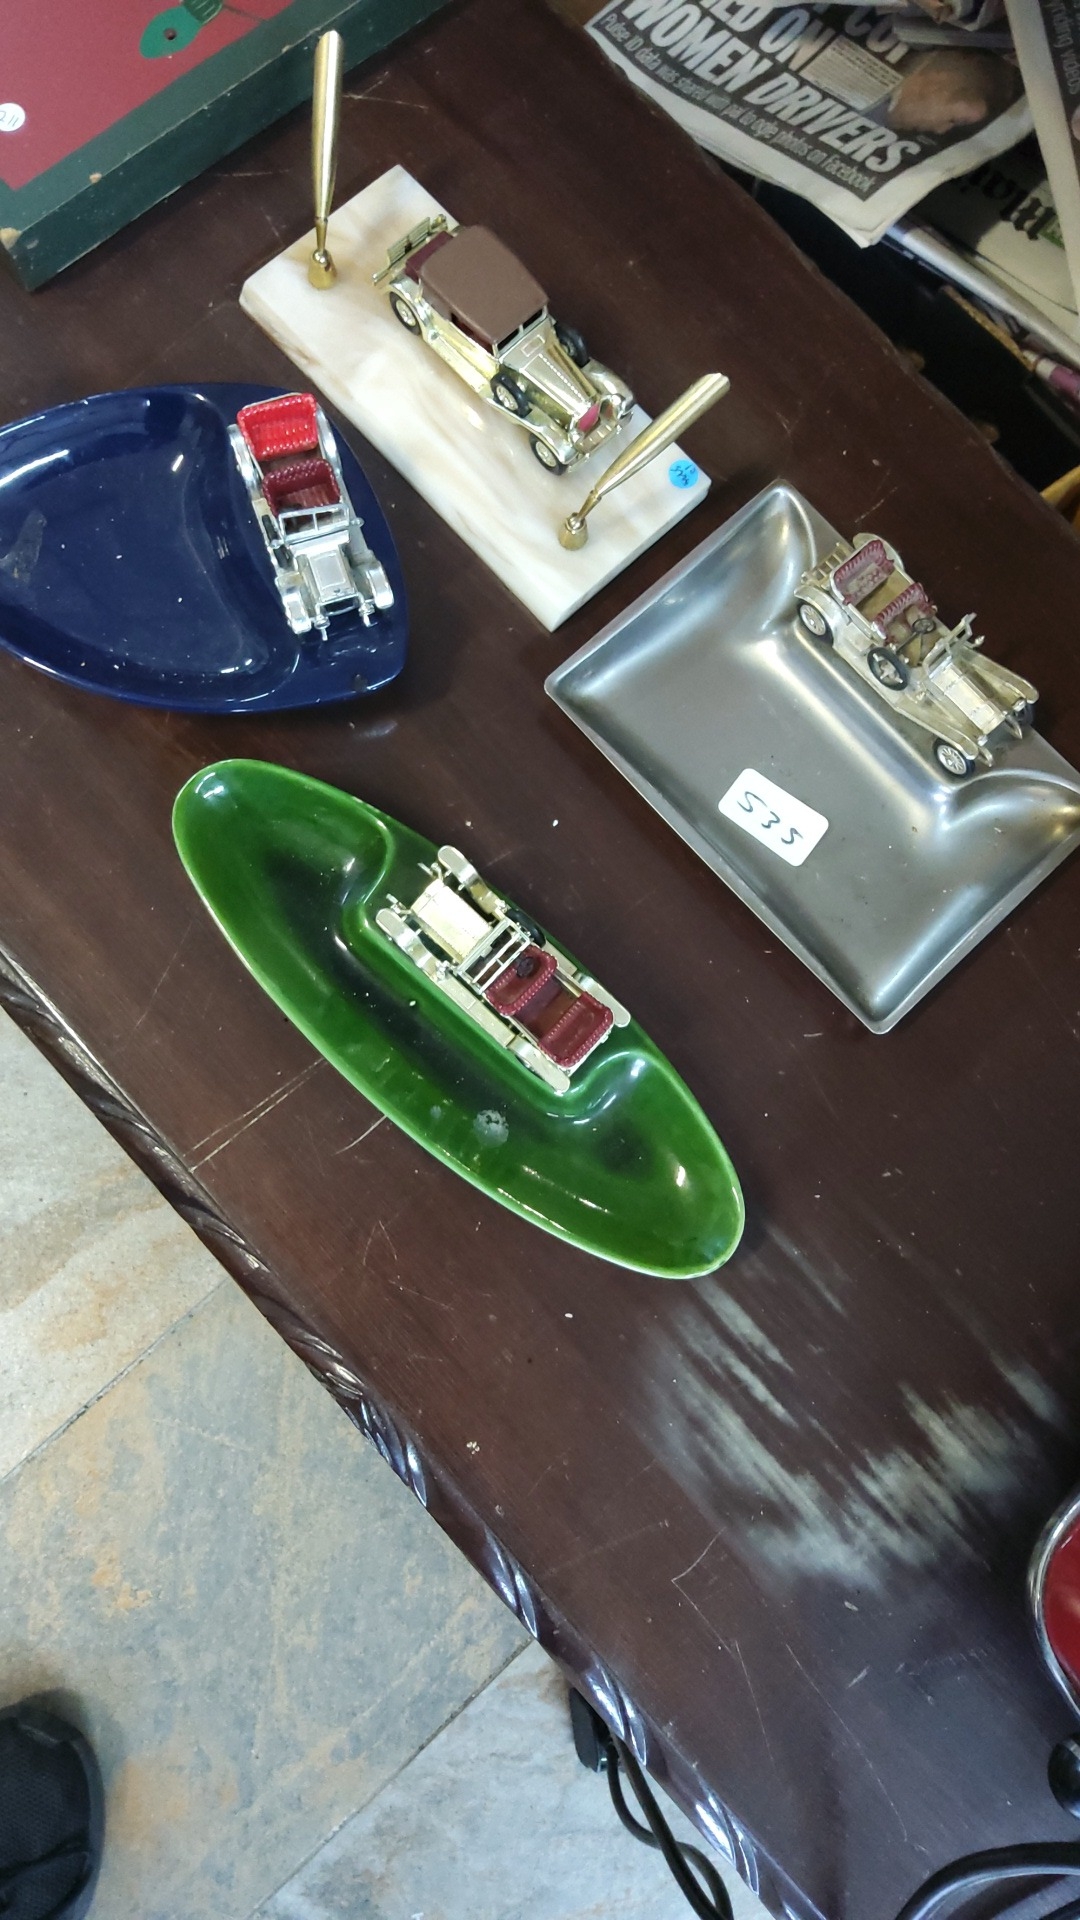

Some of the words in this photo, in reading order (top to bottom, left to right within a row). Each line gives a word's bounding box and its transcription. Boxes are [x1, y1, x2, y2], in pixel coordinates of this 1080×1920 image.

[621, 0, 775, 94] WOMEN
[742, 71, 922, 173] DRIVERS
[758, 8, 836, 72] ON
[634, 47, 662, 71] data
[806, 149, 828, 165] on
[822, 154, 876, 192] Facebook
[955, 159, 1056, 241] Mai
